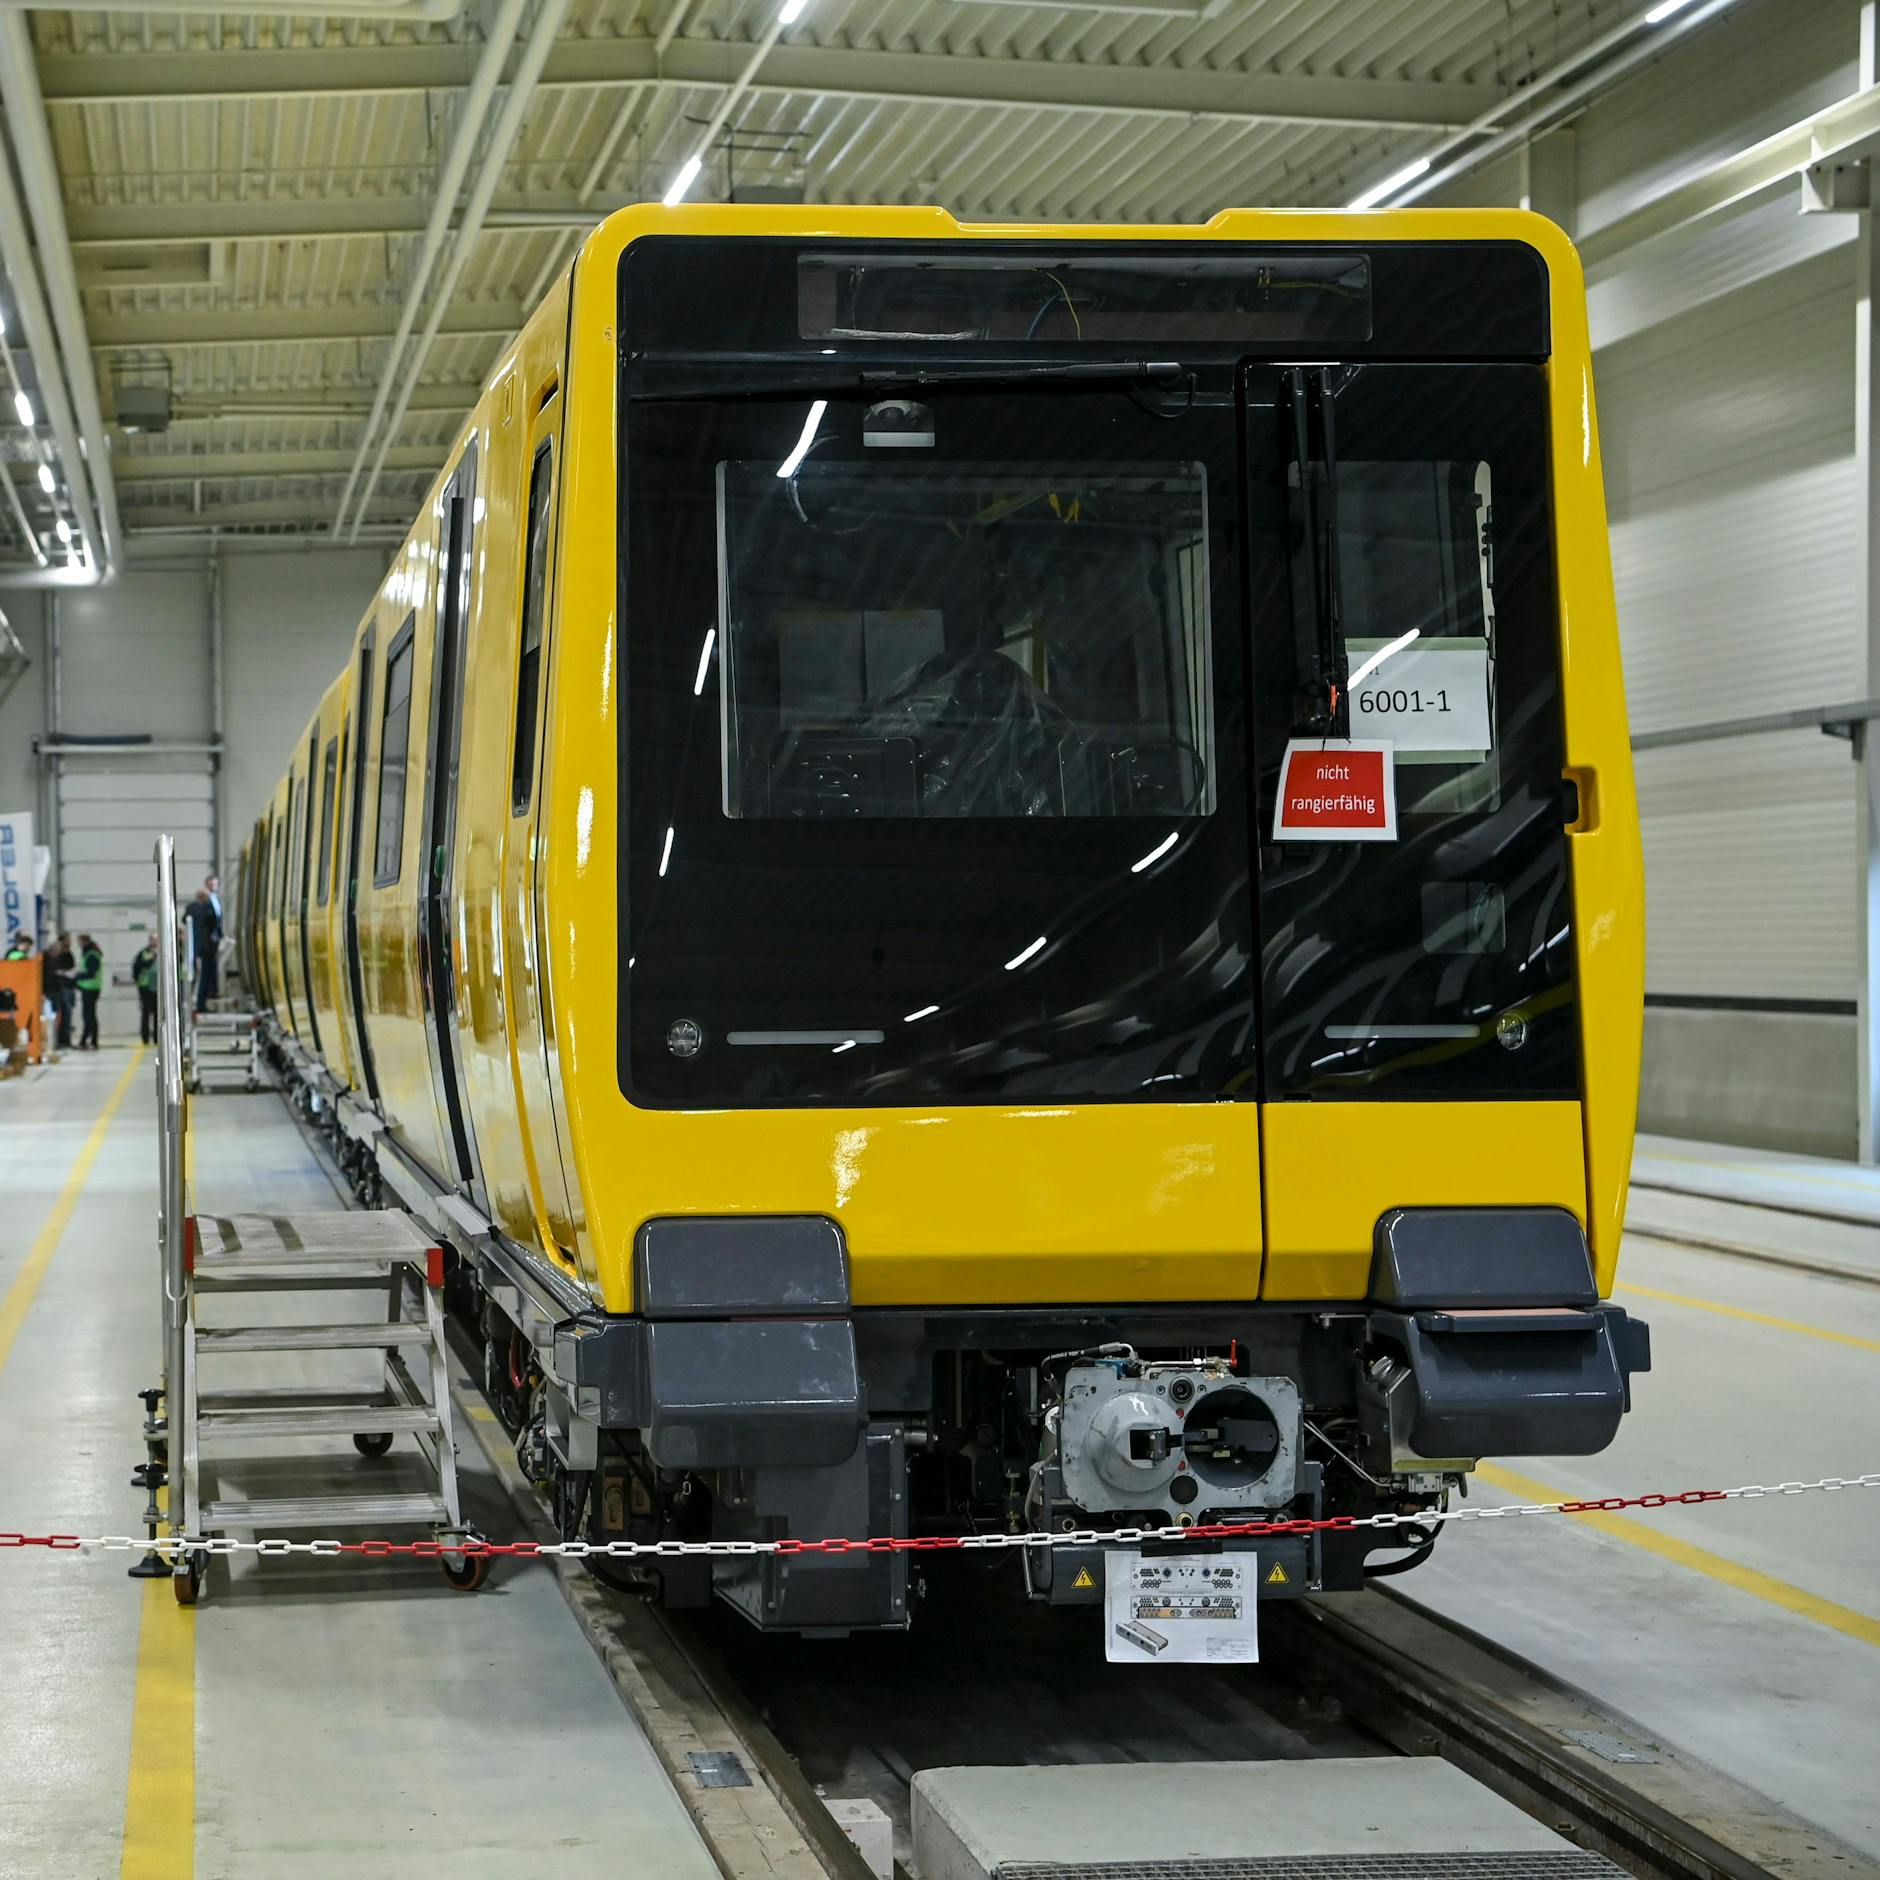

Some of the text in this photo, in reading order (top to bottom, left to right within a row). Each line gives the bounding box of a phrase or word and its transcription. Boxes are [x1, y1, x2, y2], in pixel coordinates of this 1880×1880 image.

[1360, 689, 1452, 713] 6001-1
[1316, 764, 1350, 780] nicht
[1291, 794, 1376, 814] rangierfähig
